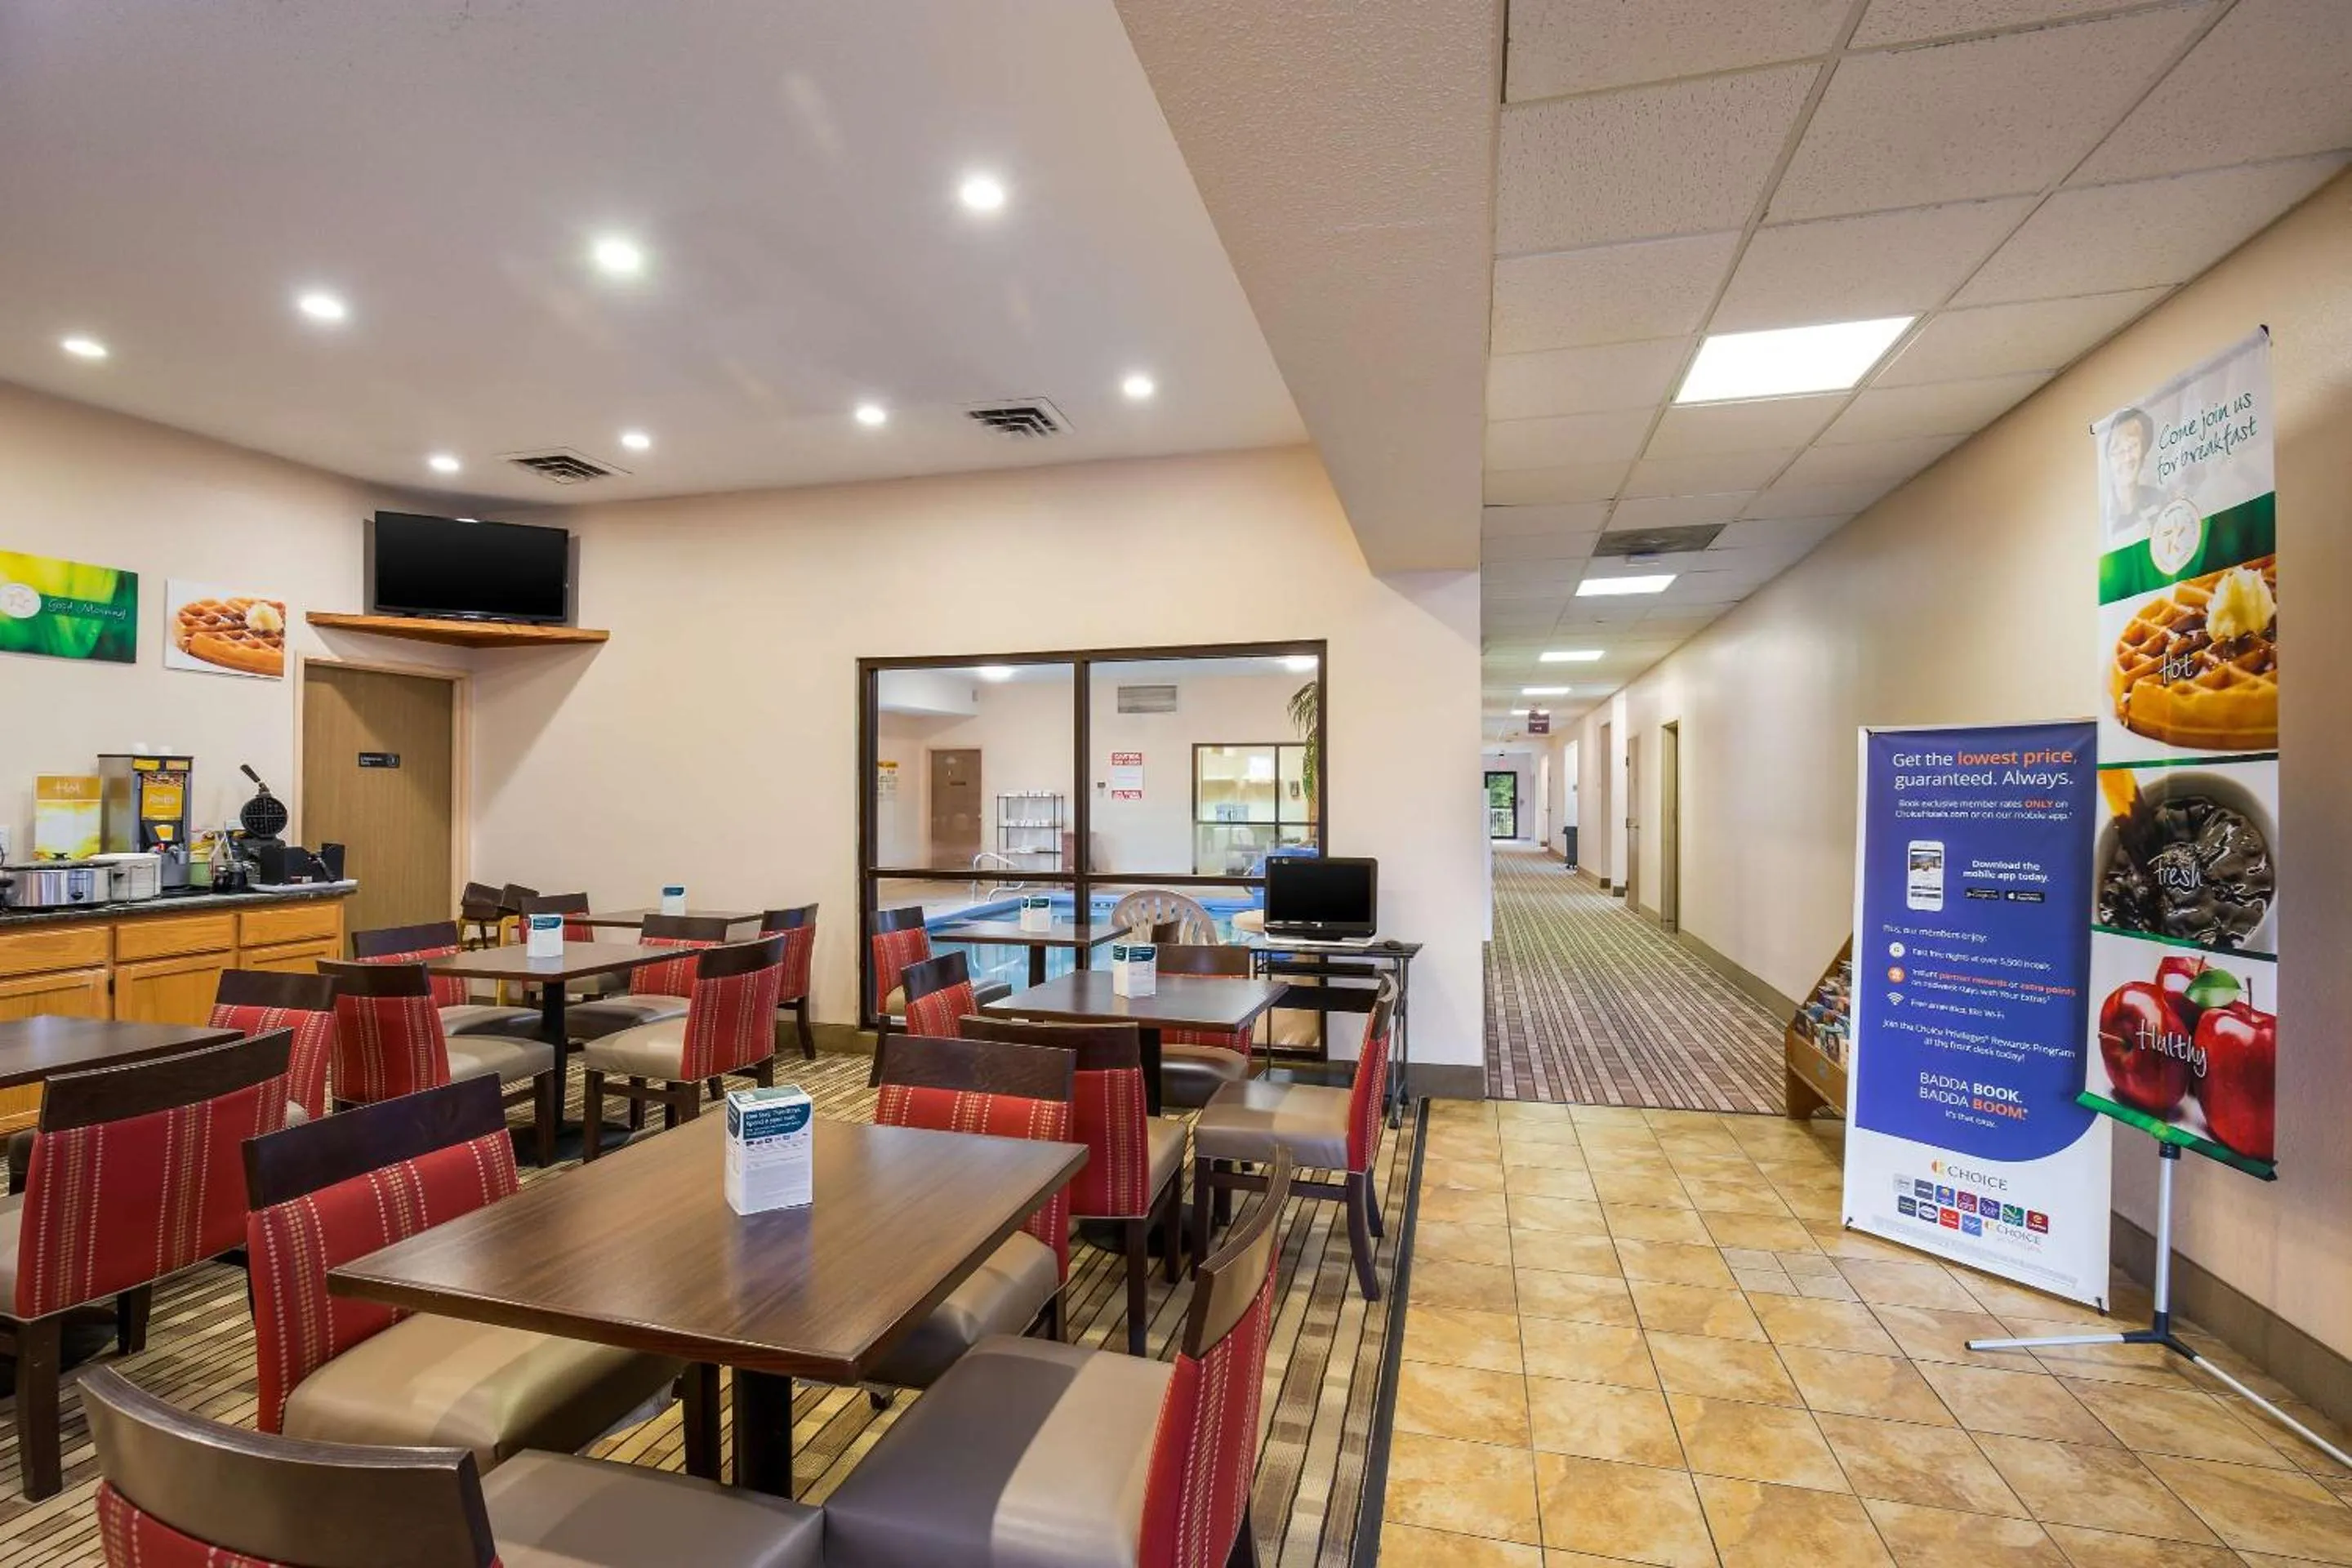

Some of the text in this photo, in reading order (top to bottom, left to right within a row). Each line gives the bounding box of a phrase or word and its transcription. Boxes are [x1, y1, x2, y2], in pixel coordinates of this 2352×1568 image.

[2159, 393, 2252, 449] Come join us
[2158, 416, 2256, 484] for breakfast
[2159, 653, 2194, 684] Hot
[1893, 753, 1921, 767] Get
[1926, 752, 1953, 766] the
[1957, 751, 2018, 765] lowest
[1894, 769, 2074, 791] guaranteed. Always.
[1922, 800, 1959, 808] exclusive
[1960, 800, 1998, 808] member
[2025, 800, 2053, 808] ONLY
[1996, 811, 2012, 819] our
[2015, 810, 2047, 819] mobile
[1962, 870, 1995, 879] mobile
[1998, 872, 2016, 882] app
[1971, 860, 2041, 871] Download the
[2147, 854, 2204, 889] Fresh
[1918, 929, 1960, 939] members
[2033, 1044, 2075, 1058] Program
[1919, 1086, 1969, 1107] BADDA
[1920, 1071, 2023, 1103] BADDA BOOK.
[1947, 1165, 2008, 1191] CHOICE
[1996, 1224, 2042, 1245] CHOICE
